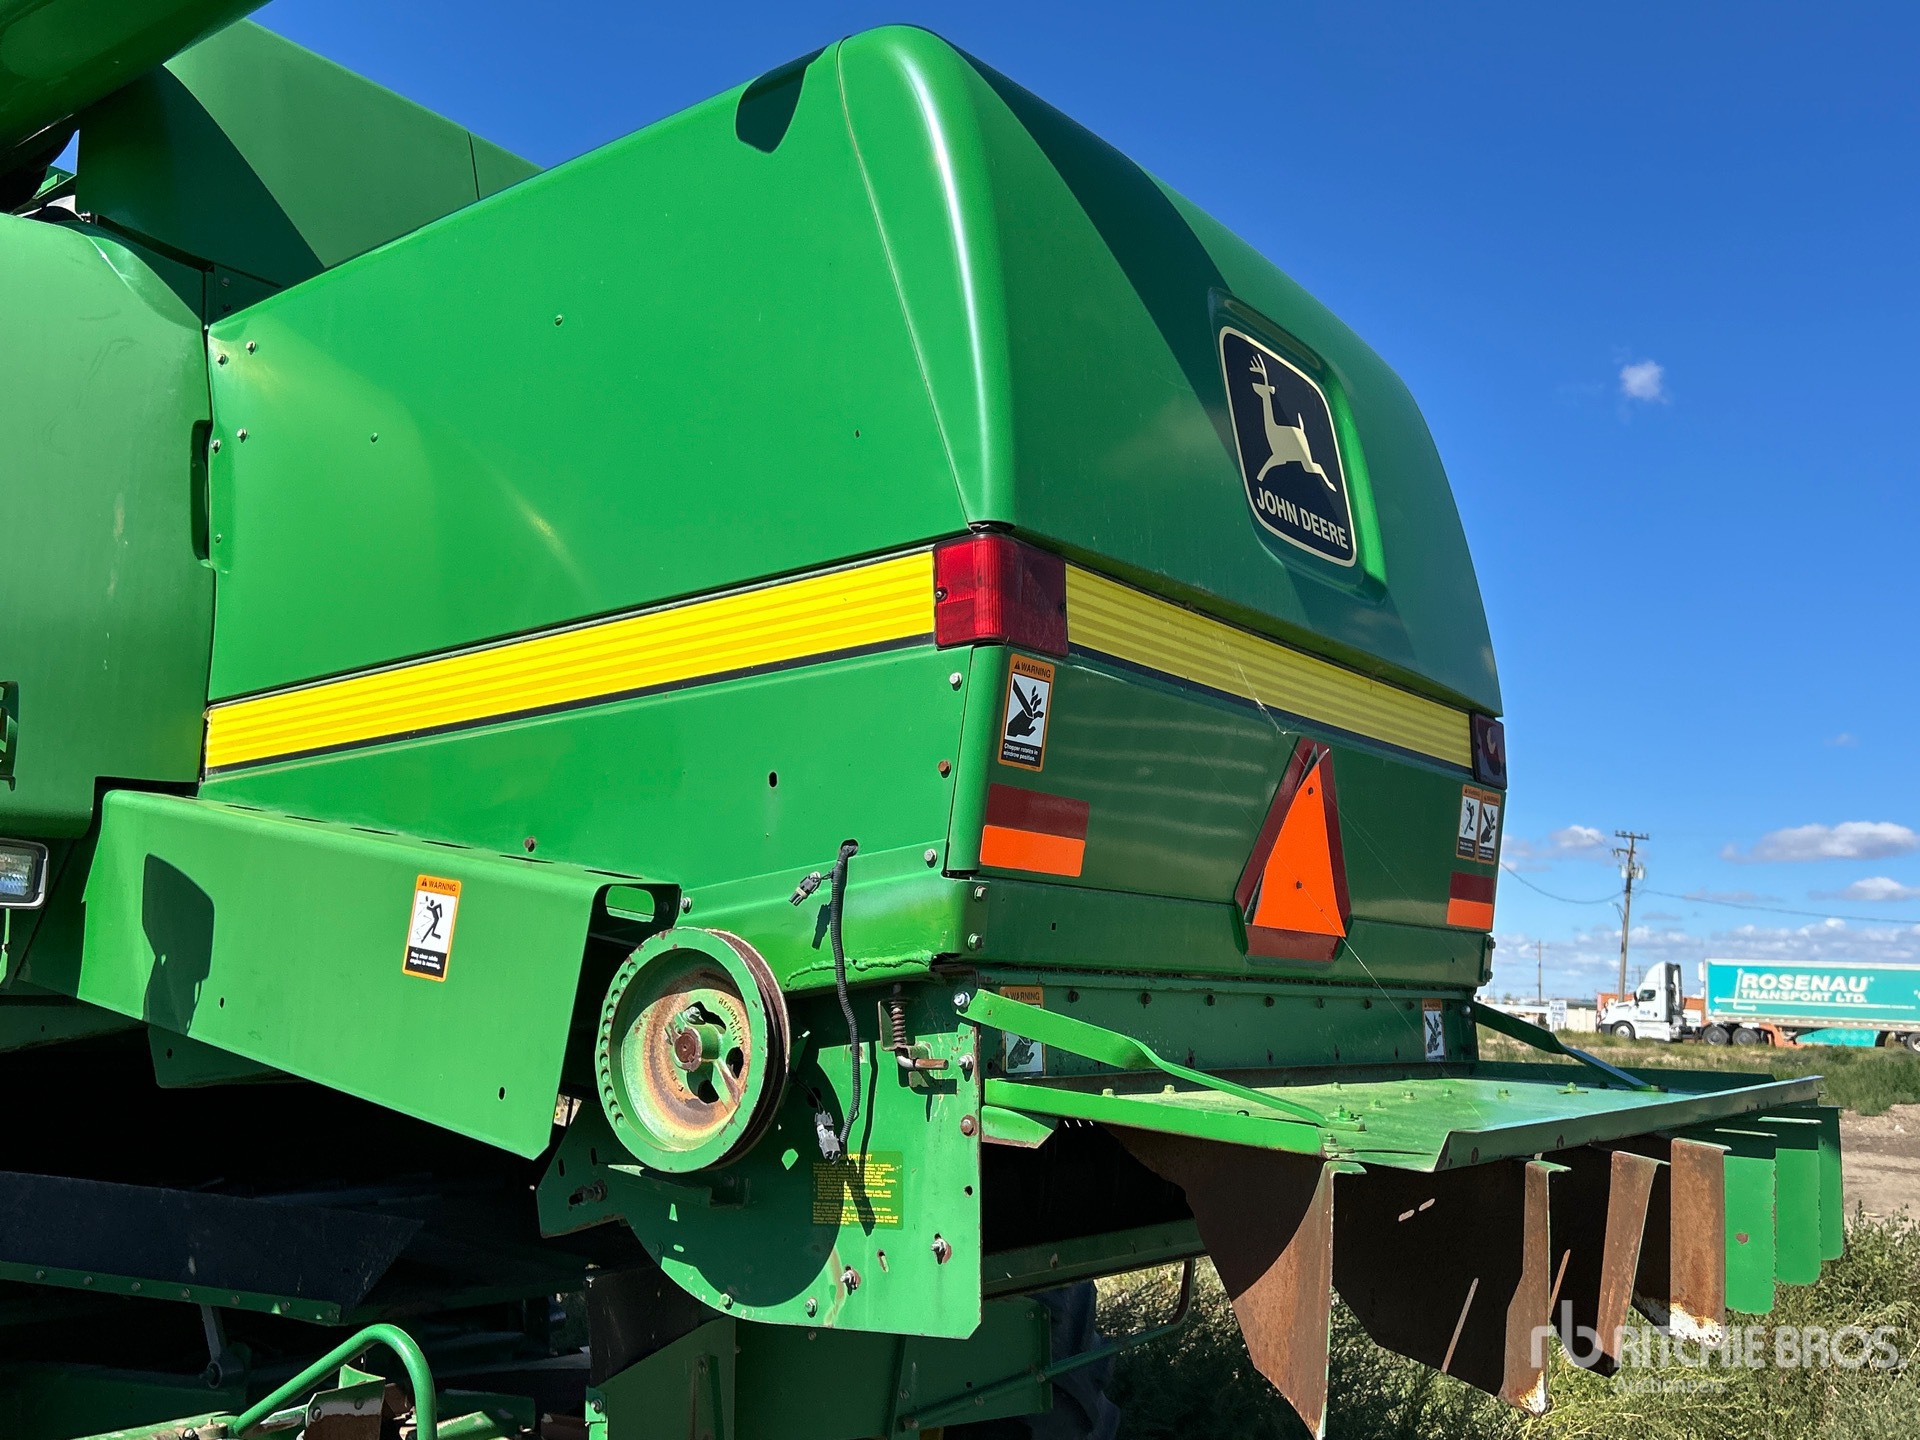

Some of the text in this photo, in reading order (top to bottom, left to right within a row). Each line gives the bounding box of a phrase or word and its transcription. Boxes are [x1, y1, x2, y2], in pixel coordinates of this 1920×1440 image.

[1257, 487, 1349, 550] JOHN DEERE
[1021, 662, 1051, 678] WARNING
[428, 880, 456, 891] WARNING
[1741, 973, 1869, 993] ROSENAU
[1011, 991, 1040, 1000] WARNING
[1741, 989, 1867, 1003] TRANSPORT LTD.
